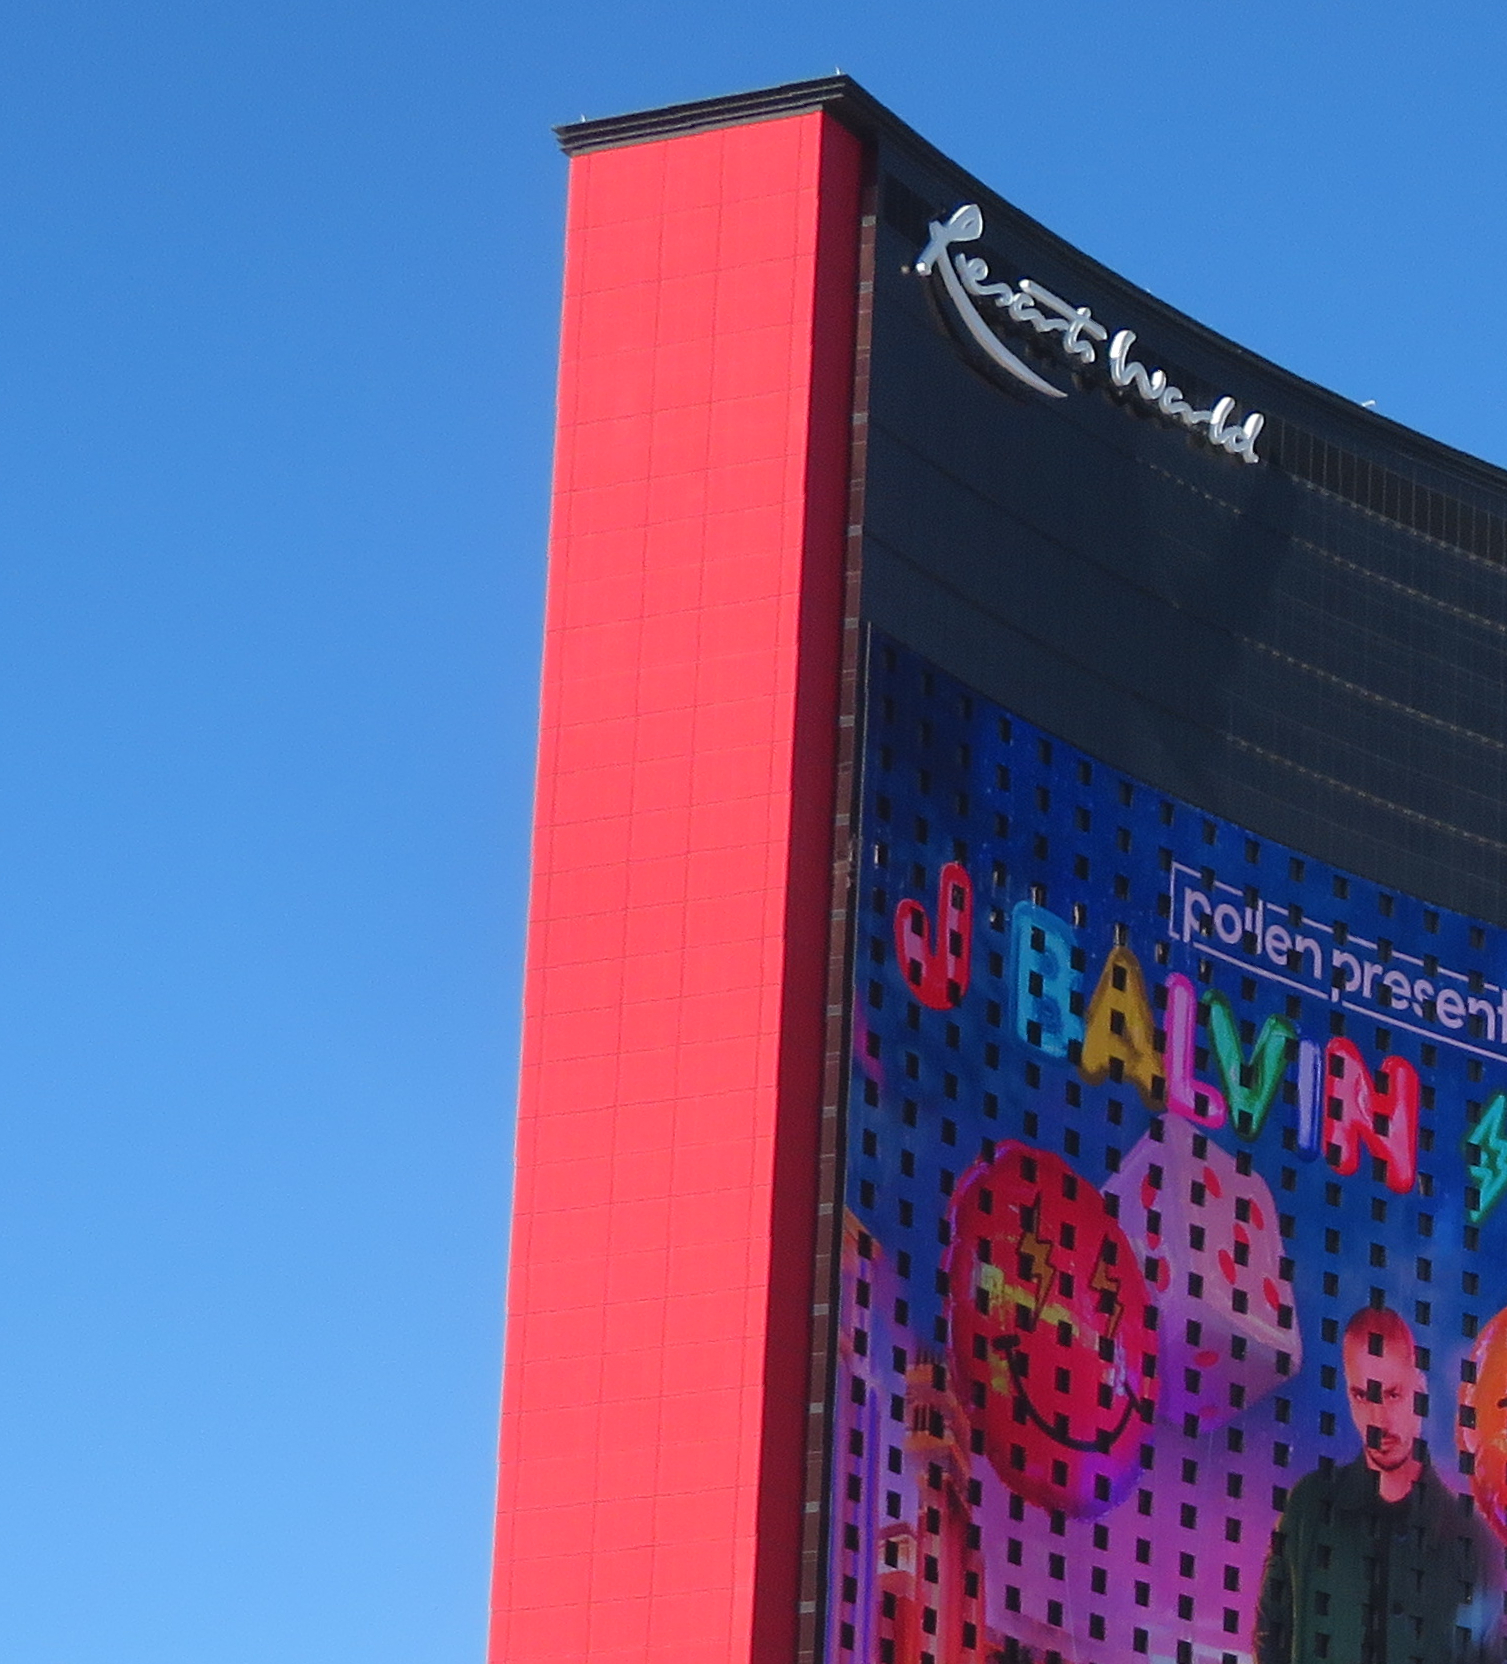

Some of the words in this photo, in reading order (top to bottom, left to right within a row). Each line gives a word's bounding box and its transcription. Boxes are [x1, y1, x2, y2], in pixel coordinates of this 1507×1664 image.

[916, 203, 1107, 397] Resorts
[1110, 329, 1265, 463] World
[893, 862, 974, 1011] J
[1010, 899, 1420, 1195] BALVIN
[1183, 886, 1323, 980] pollen
